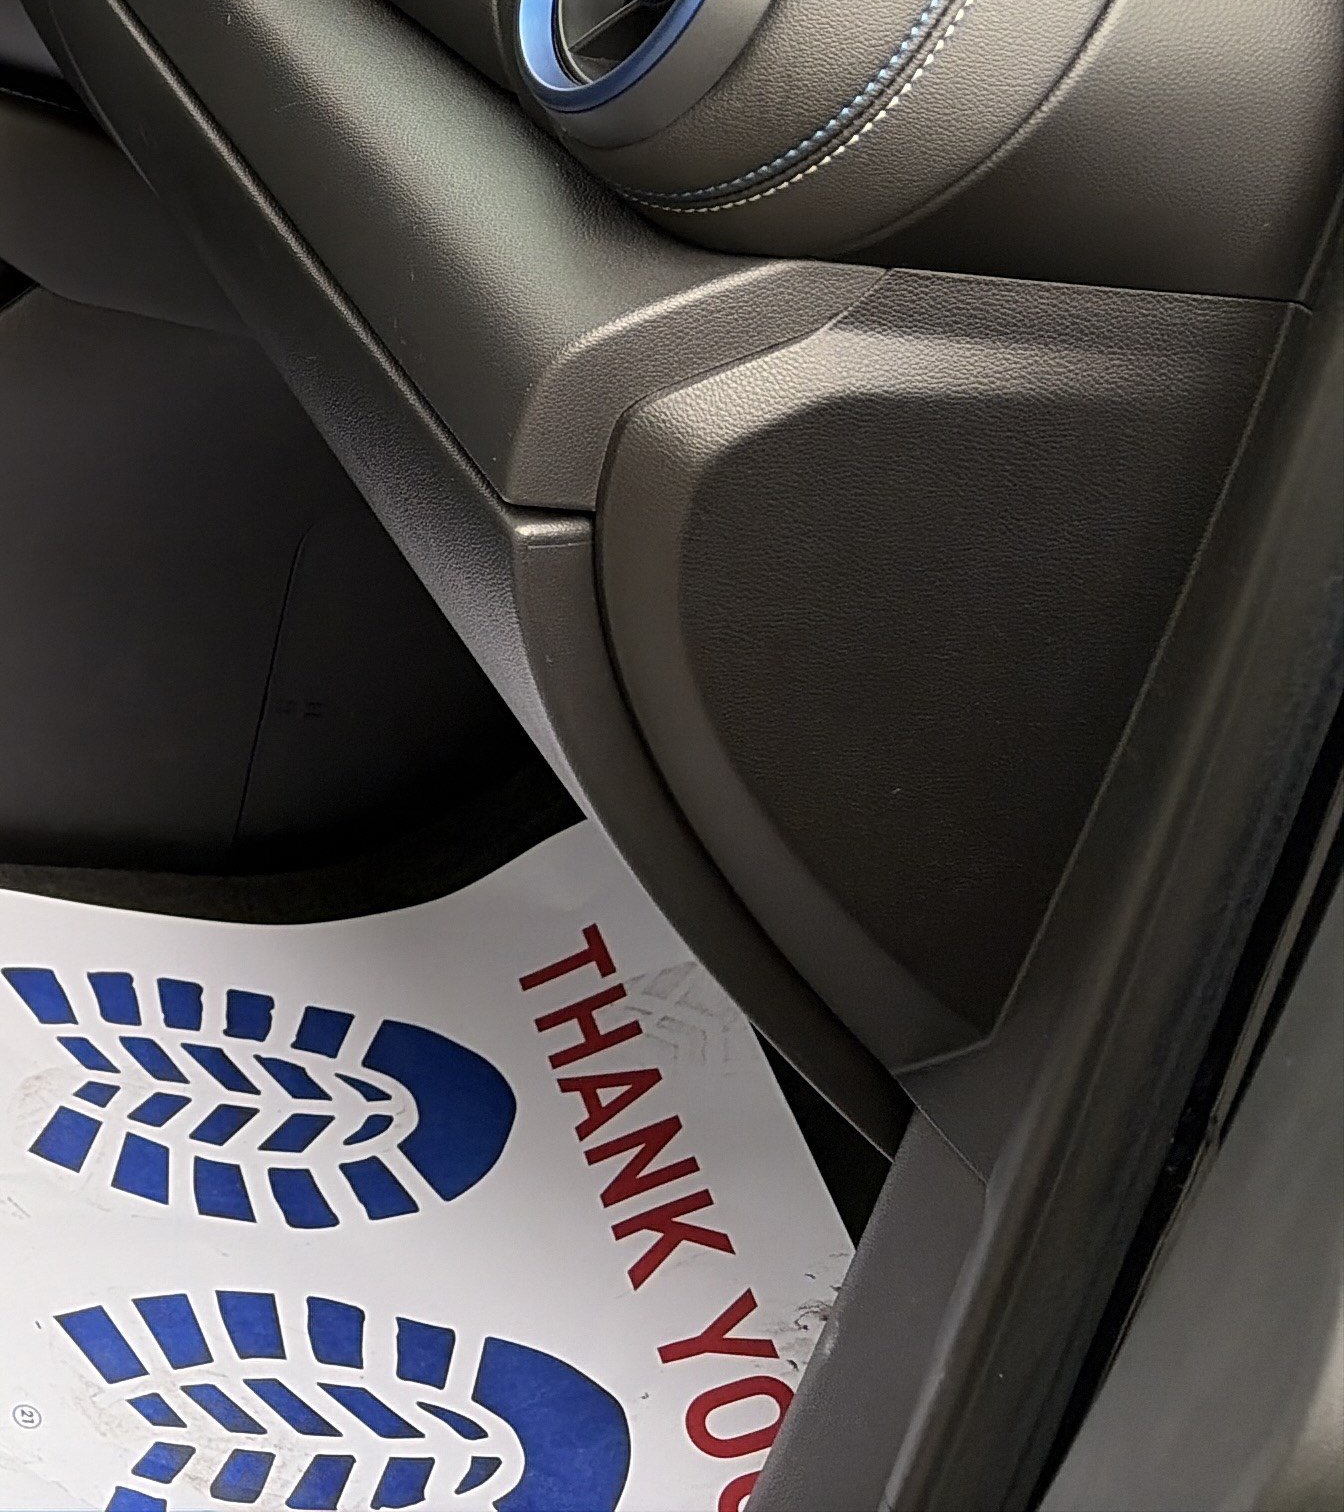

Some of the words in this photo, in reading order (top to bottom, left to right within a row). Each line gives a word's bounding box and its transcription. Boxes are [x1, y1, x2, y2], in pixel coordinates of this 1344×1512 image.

[519, 923, 736, 1291] THANK
[657, 1287, 795, 1512] YO
[20, 1409, 35, 1424] 21
